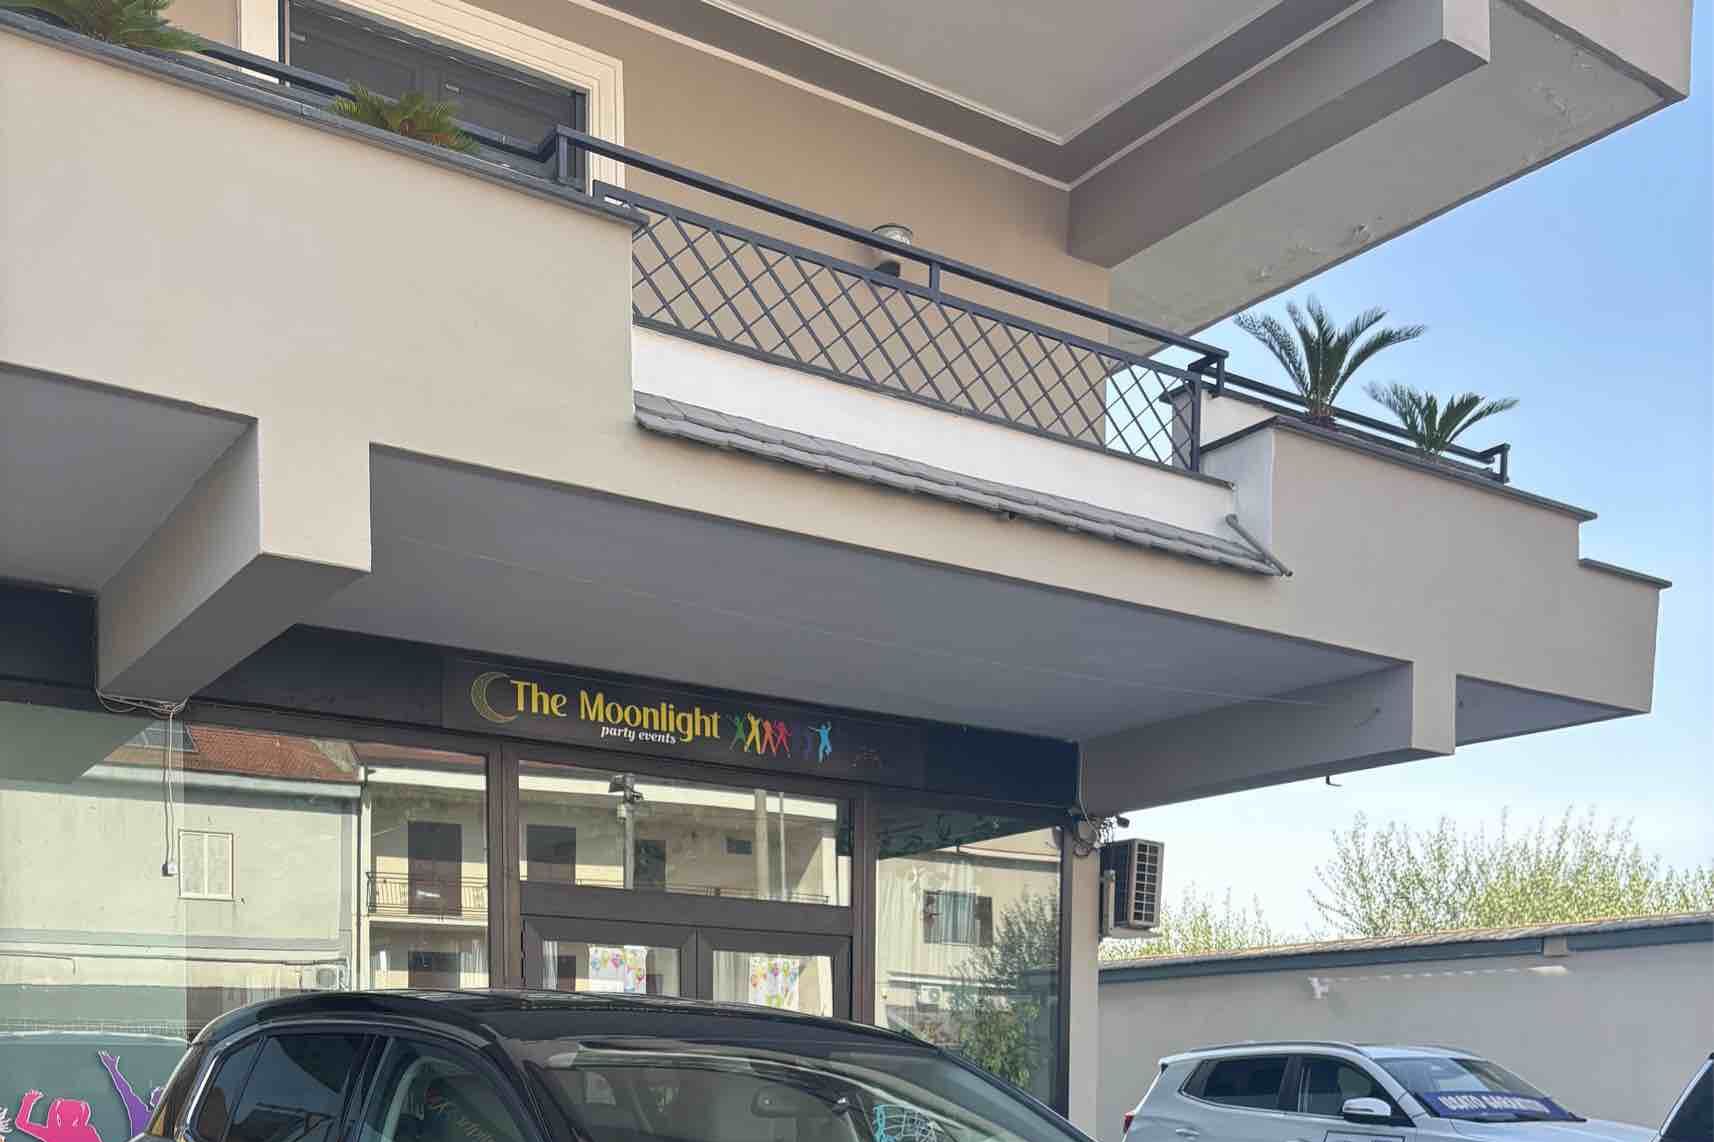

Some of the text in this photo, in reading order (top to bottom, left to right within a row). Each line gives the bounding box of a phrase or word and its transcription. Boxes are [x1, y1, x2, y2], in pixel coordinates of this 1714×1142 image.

[511, 679, 721, 743] The Moonlight
[601, 725, 677, 745] party events
